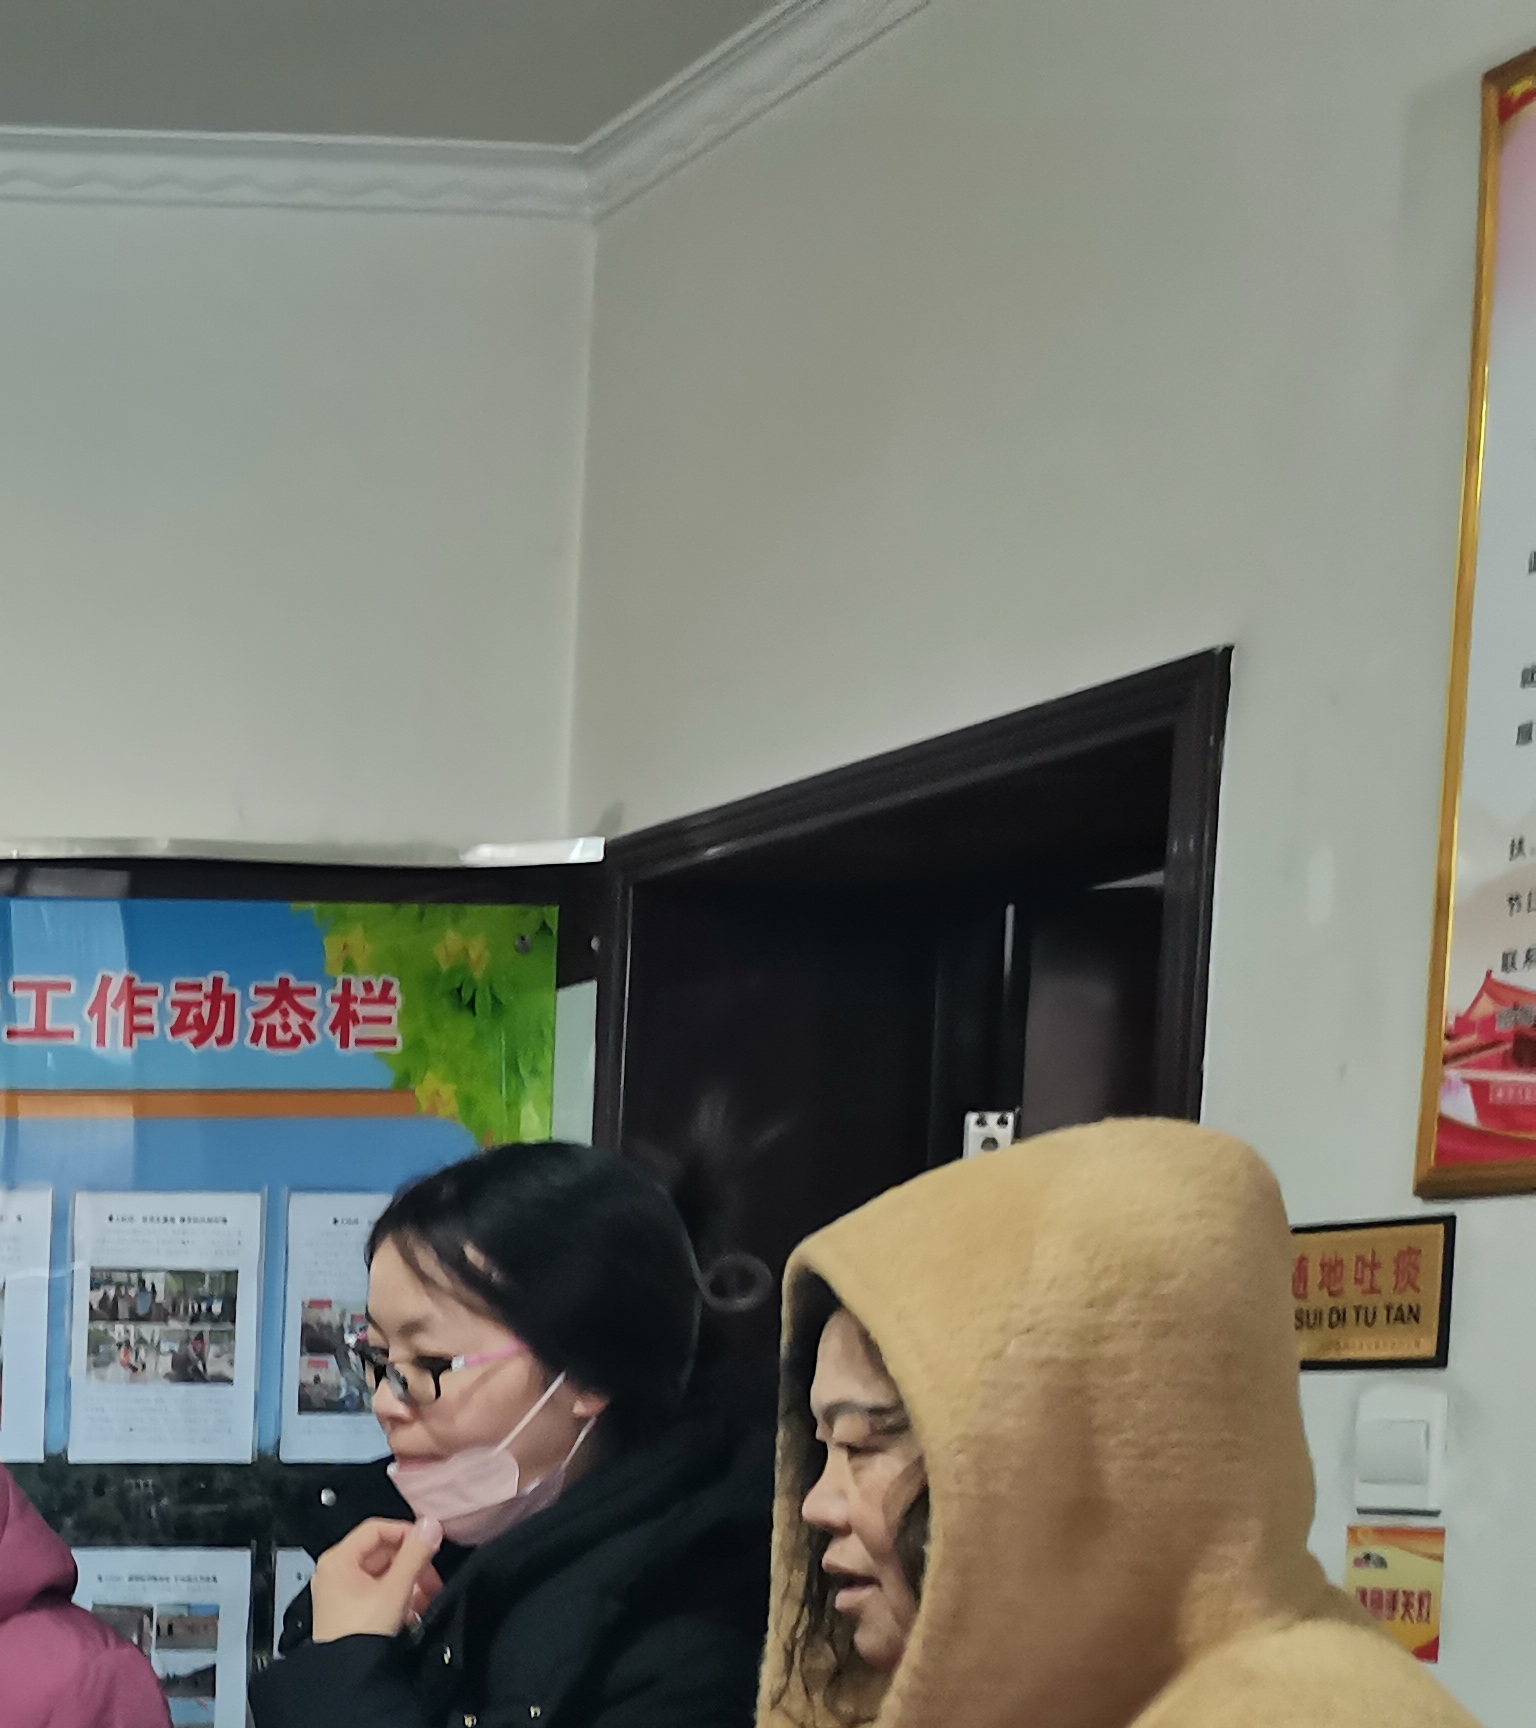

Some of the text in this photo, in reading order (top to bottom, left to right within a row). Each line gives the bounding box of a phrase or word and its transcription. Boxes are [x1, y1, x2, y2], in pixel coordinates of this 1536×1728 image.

[1294, 1303, 1421, 1331] SUI DI TU TAN
